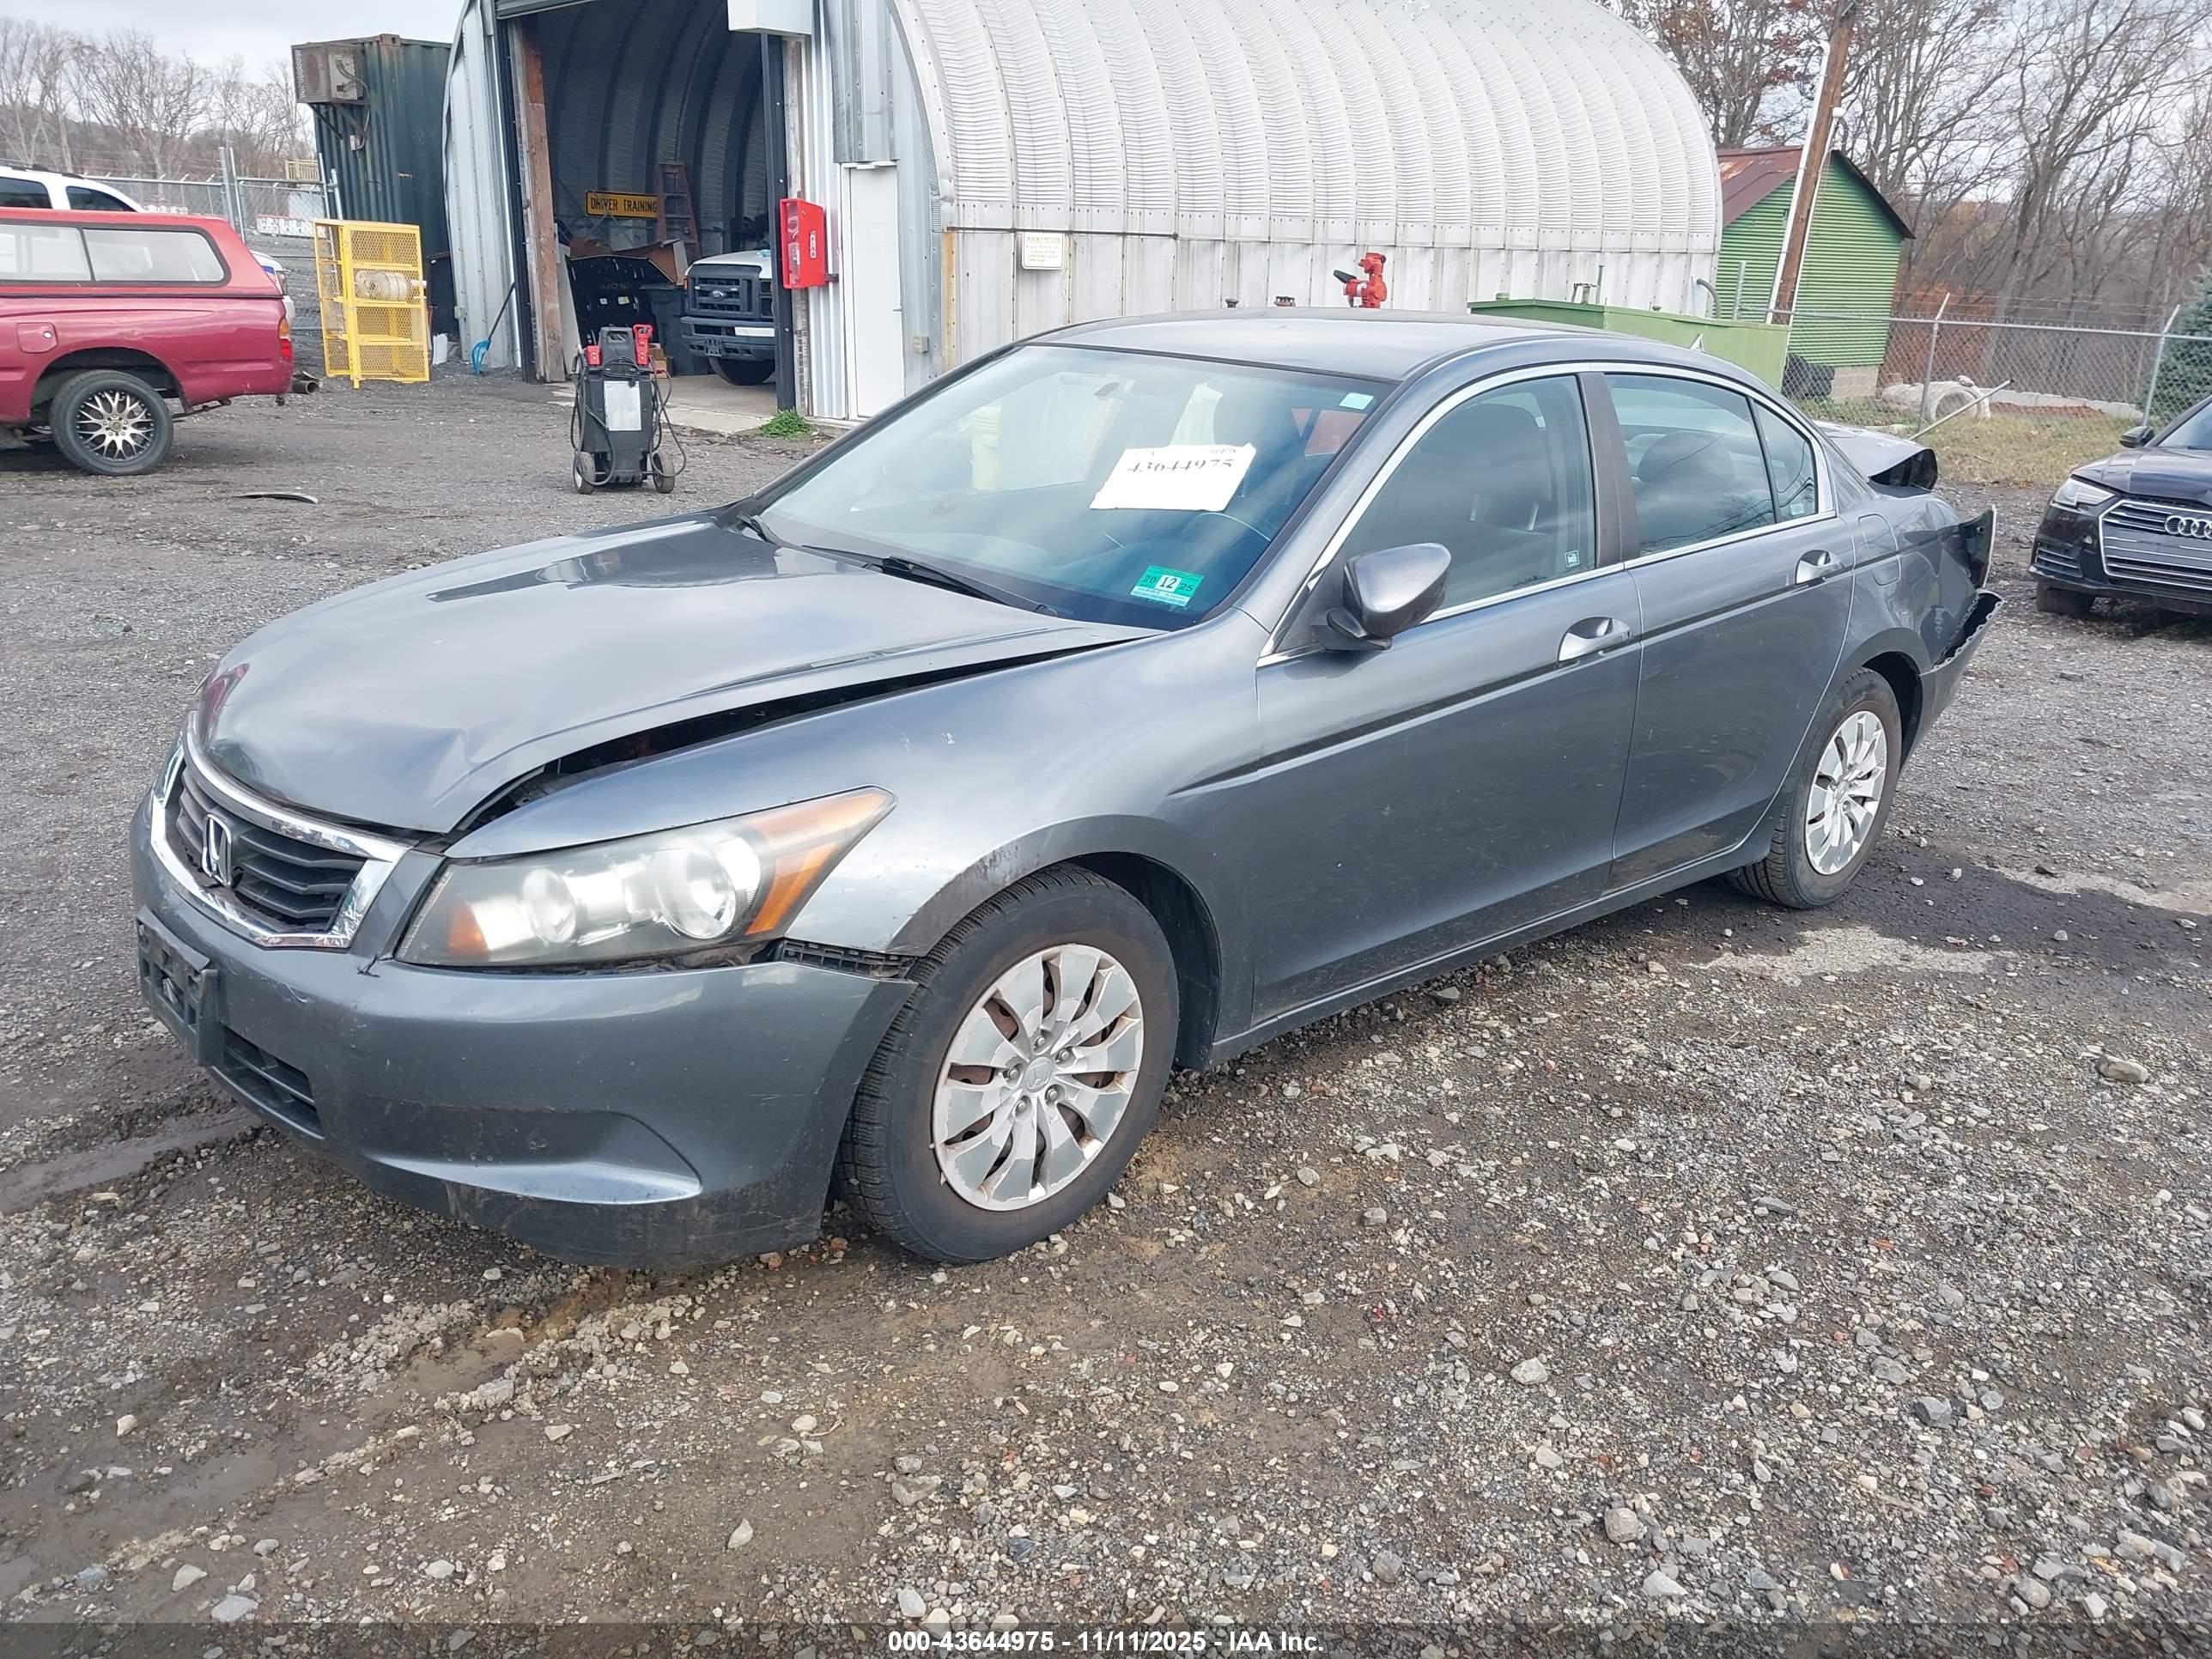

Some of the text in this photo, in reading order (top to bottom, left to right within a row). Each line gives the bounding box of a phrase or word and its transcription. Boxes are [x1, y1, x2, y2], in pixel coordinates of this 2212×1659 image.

[590, 197, 658, 213] DRIVER TRAINING
[1143, 574, 1195, 592] 20 12 25
